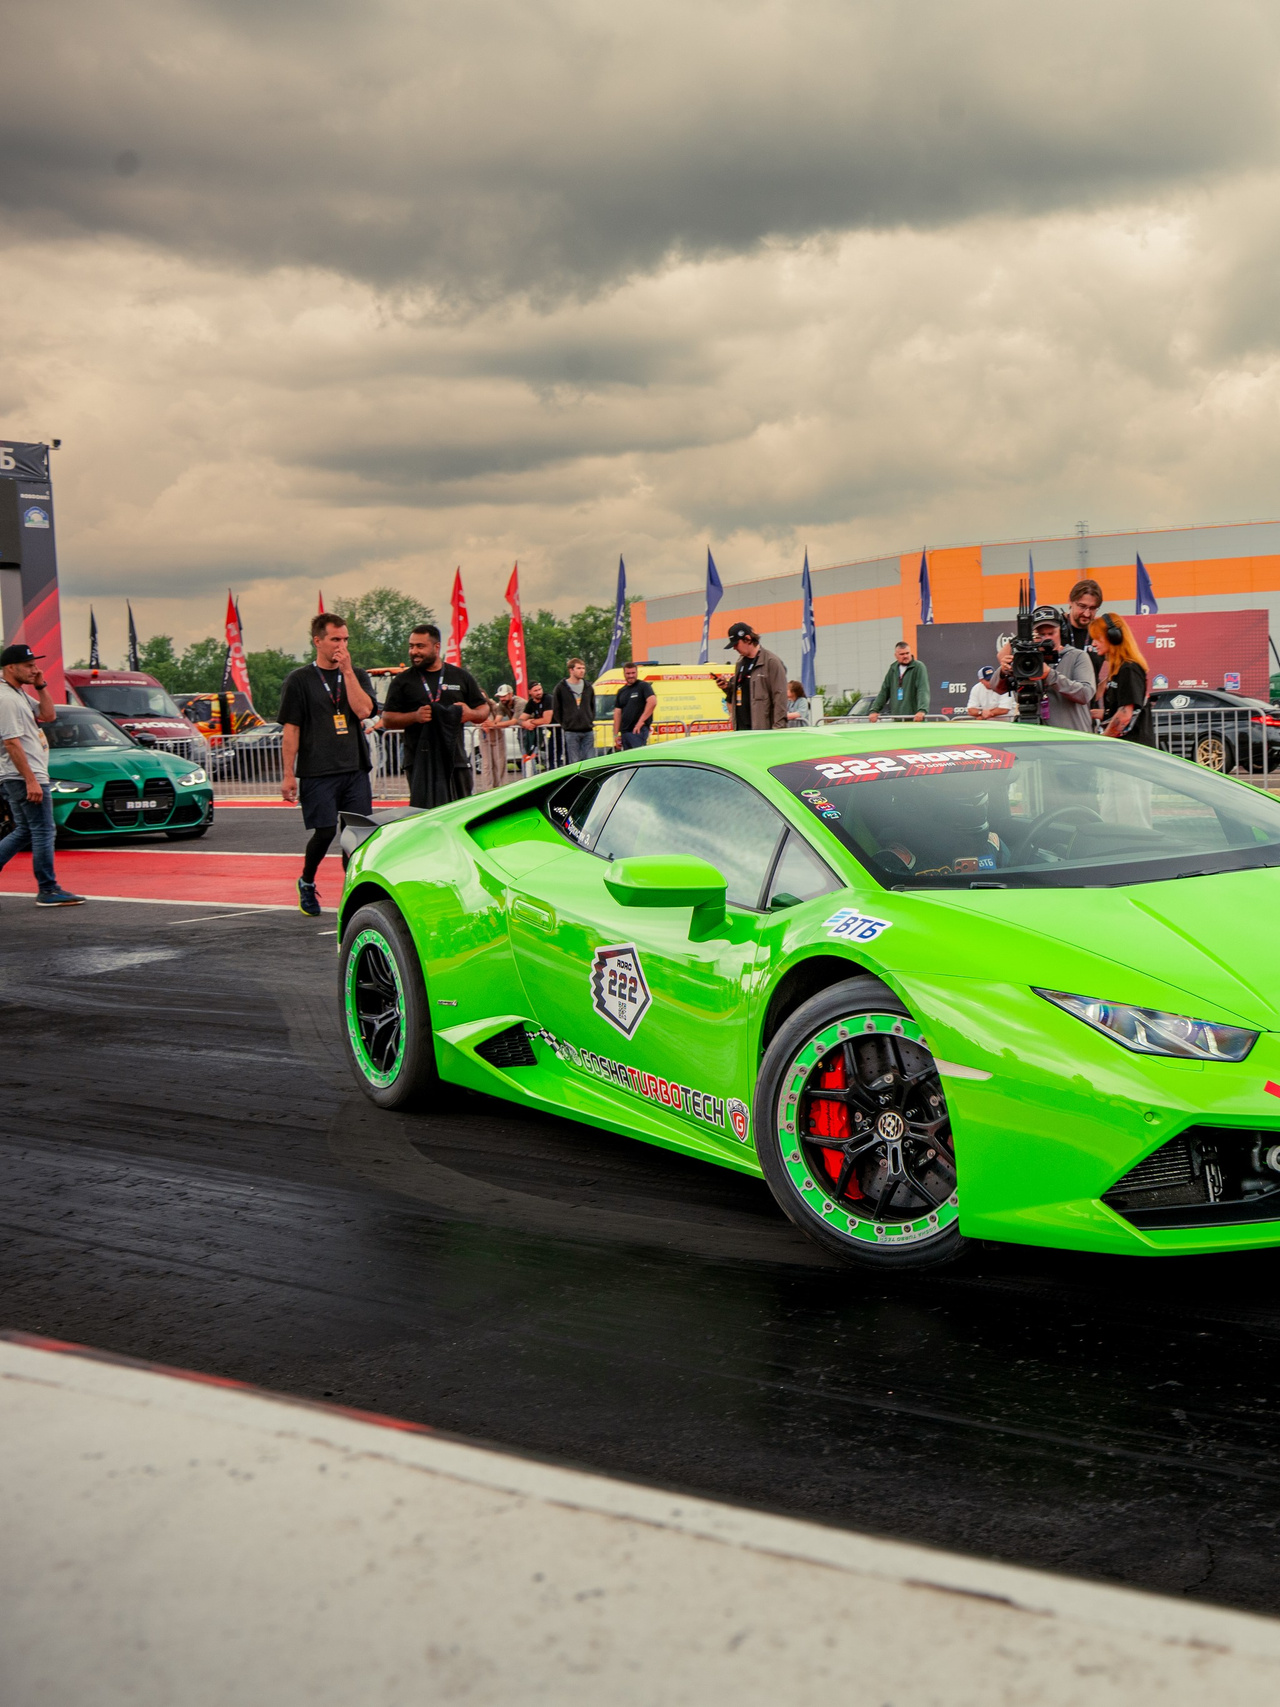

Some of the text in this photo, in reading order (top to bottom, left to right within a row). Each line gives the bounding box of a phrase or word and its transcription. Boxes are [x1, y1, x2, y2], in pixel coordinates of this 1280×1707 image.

[1155, 637, 1176, 648] ВТБ
[948, 682, 967, 694] ВТБ
[814, 749, 994, 780] 222 RDRC
[833, 916, 886, 939] ВТБ
[616, 959, 633, 972] RDRC
[608, 968, 638, 1005] 222
[580, 1048, 725, 1128] GOSHATURBOTECH
[735, 1114, 744, 1132] G
